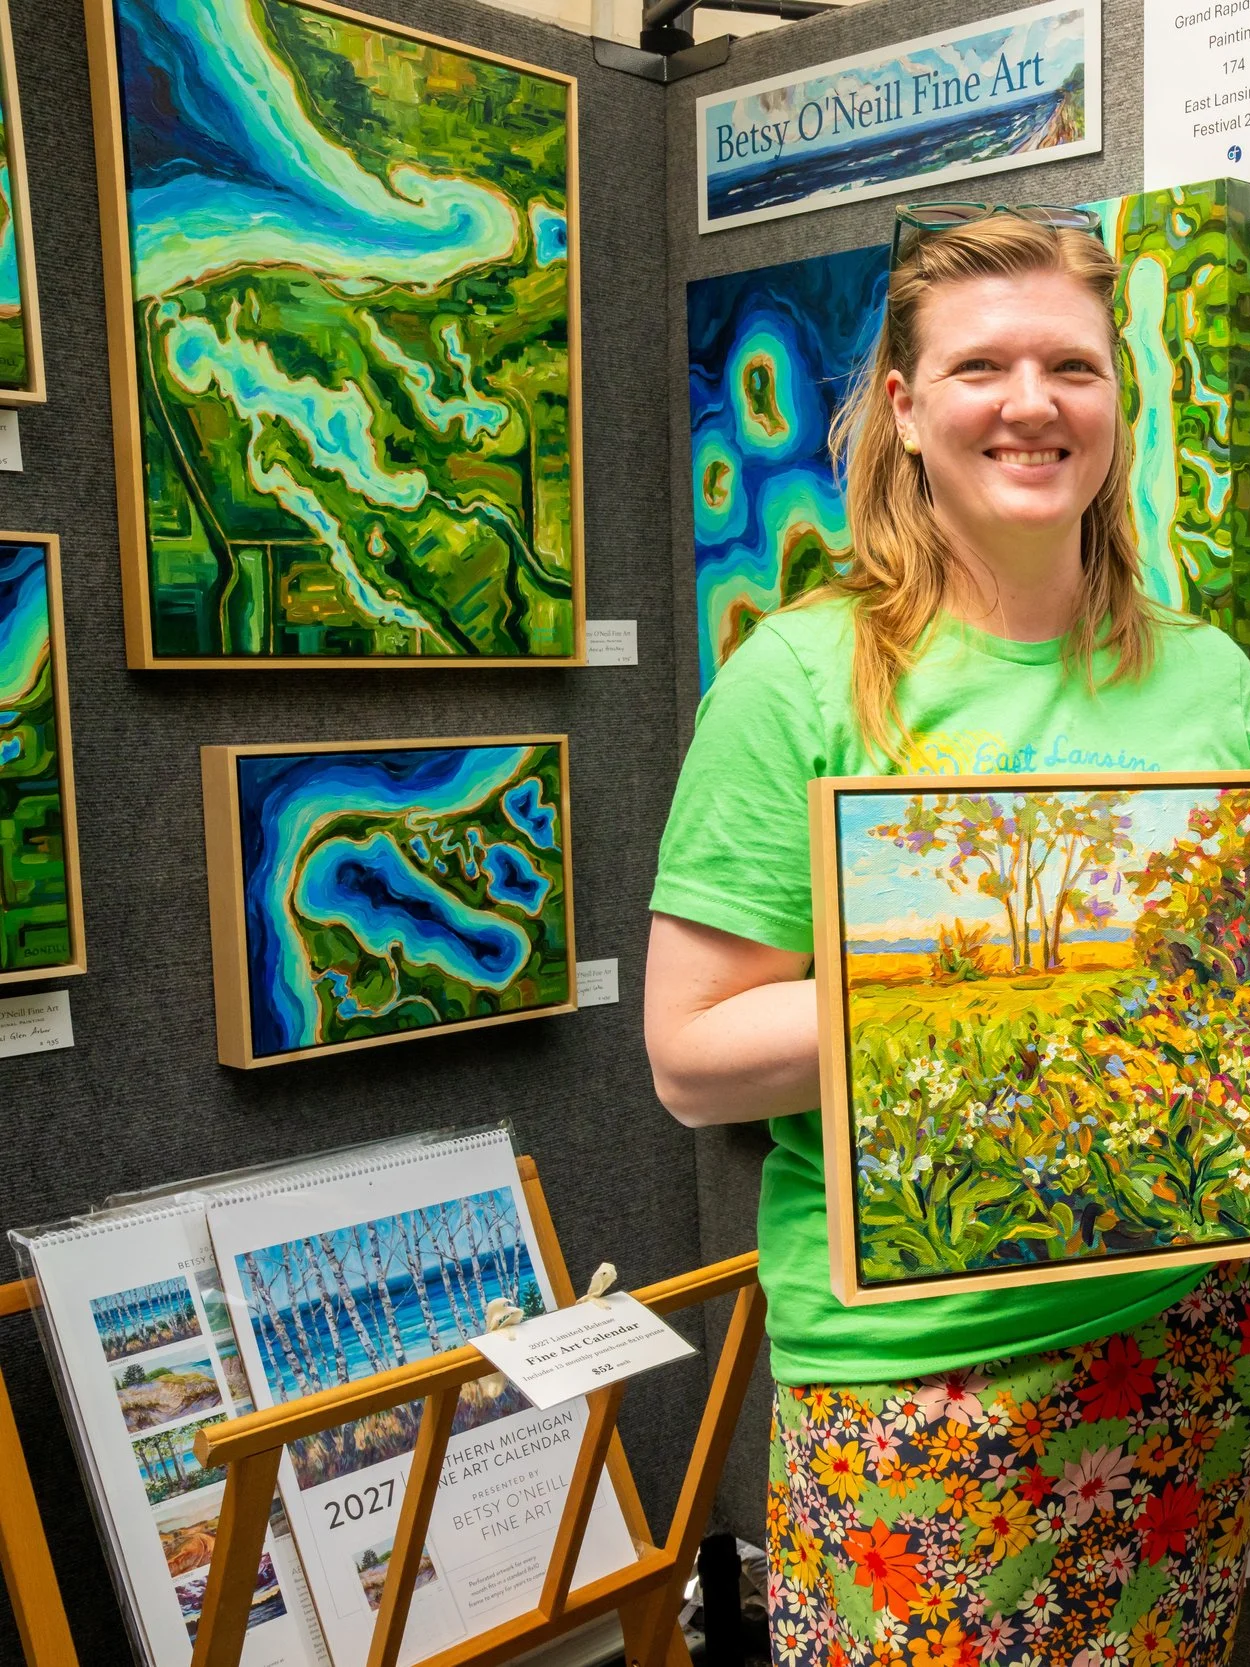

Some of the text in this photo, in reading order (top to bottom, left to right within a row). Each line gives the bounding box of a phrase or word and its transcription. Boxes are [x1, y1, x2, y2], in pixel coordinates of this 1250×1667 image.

[1175, 8, 1211, 29] Grand
[1222, 57, 1245, 75] 174
[716, 52, 1046, 160] Betsy O'Neill Fine Art
[1184, 97, 1211, 114] East
[1193, 115, 1241, 138] Festival
[972, 741, 1037, 774] East
[177, 1255, 206, 1270] BETSY
[525, 1321, 640, 1366] Fine Art Calendar
[528, 1317, 615, 1350] 2027 Limited Release
[523, 1367, 554, 1382] Includes
[565, 1353, 594, 1369] monthly
[644, 1328, 665, 1341] prints
[591, 1359, 631, 1376] $52 each
[441, 1411, 573, 1470] THERN MICHIGAN
[438, 1429, 571, 1489] NE ART CALENDAR
[472, 1469, 540, 1501] PRESENTED BY
[324, 1479, 395, 1530] 2027
[453, 1474, 569, 1530] BETSY O'NEILL
[481, 1500, 553, 1540] FINE ART
